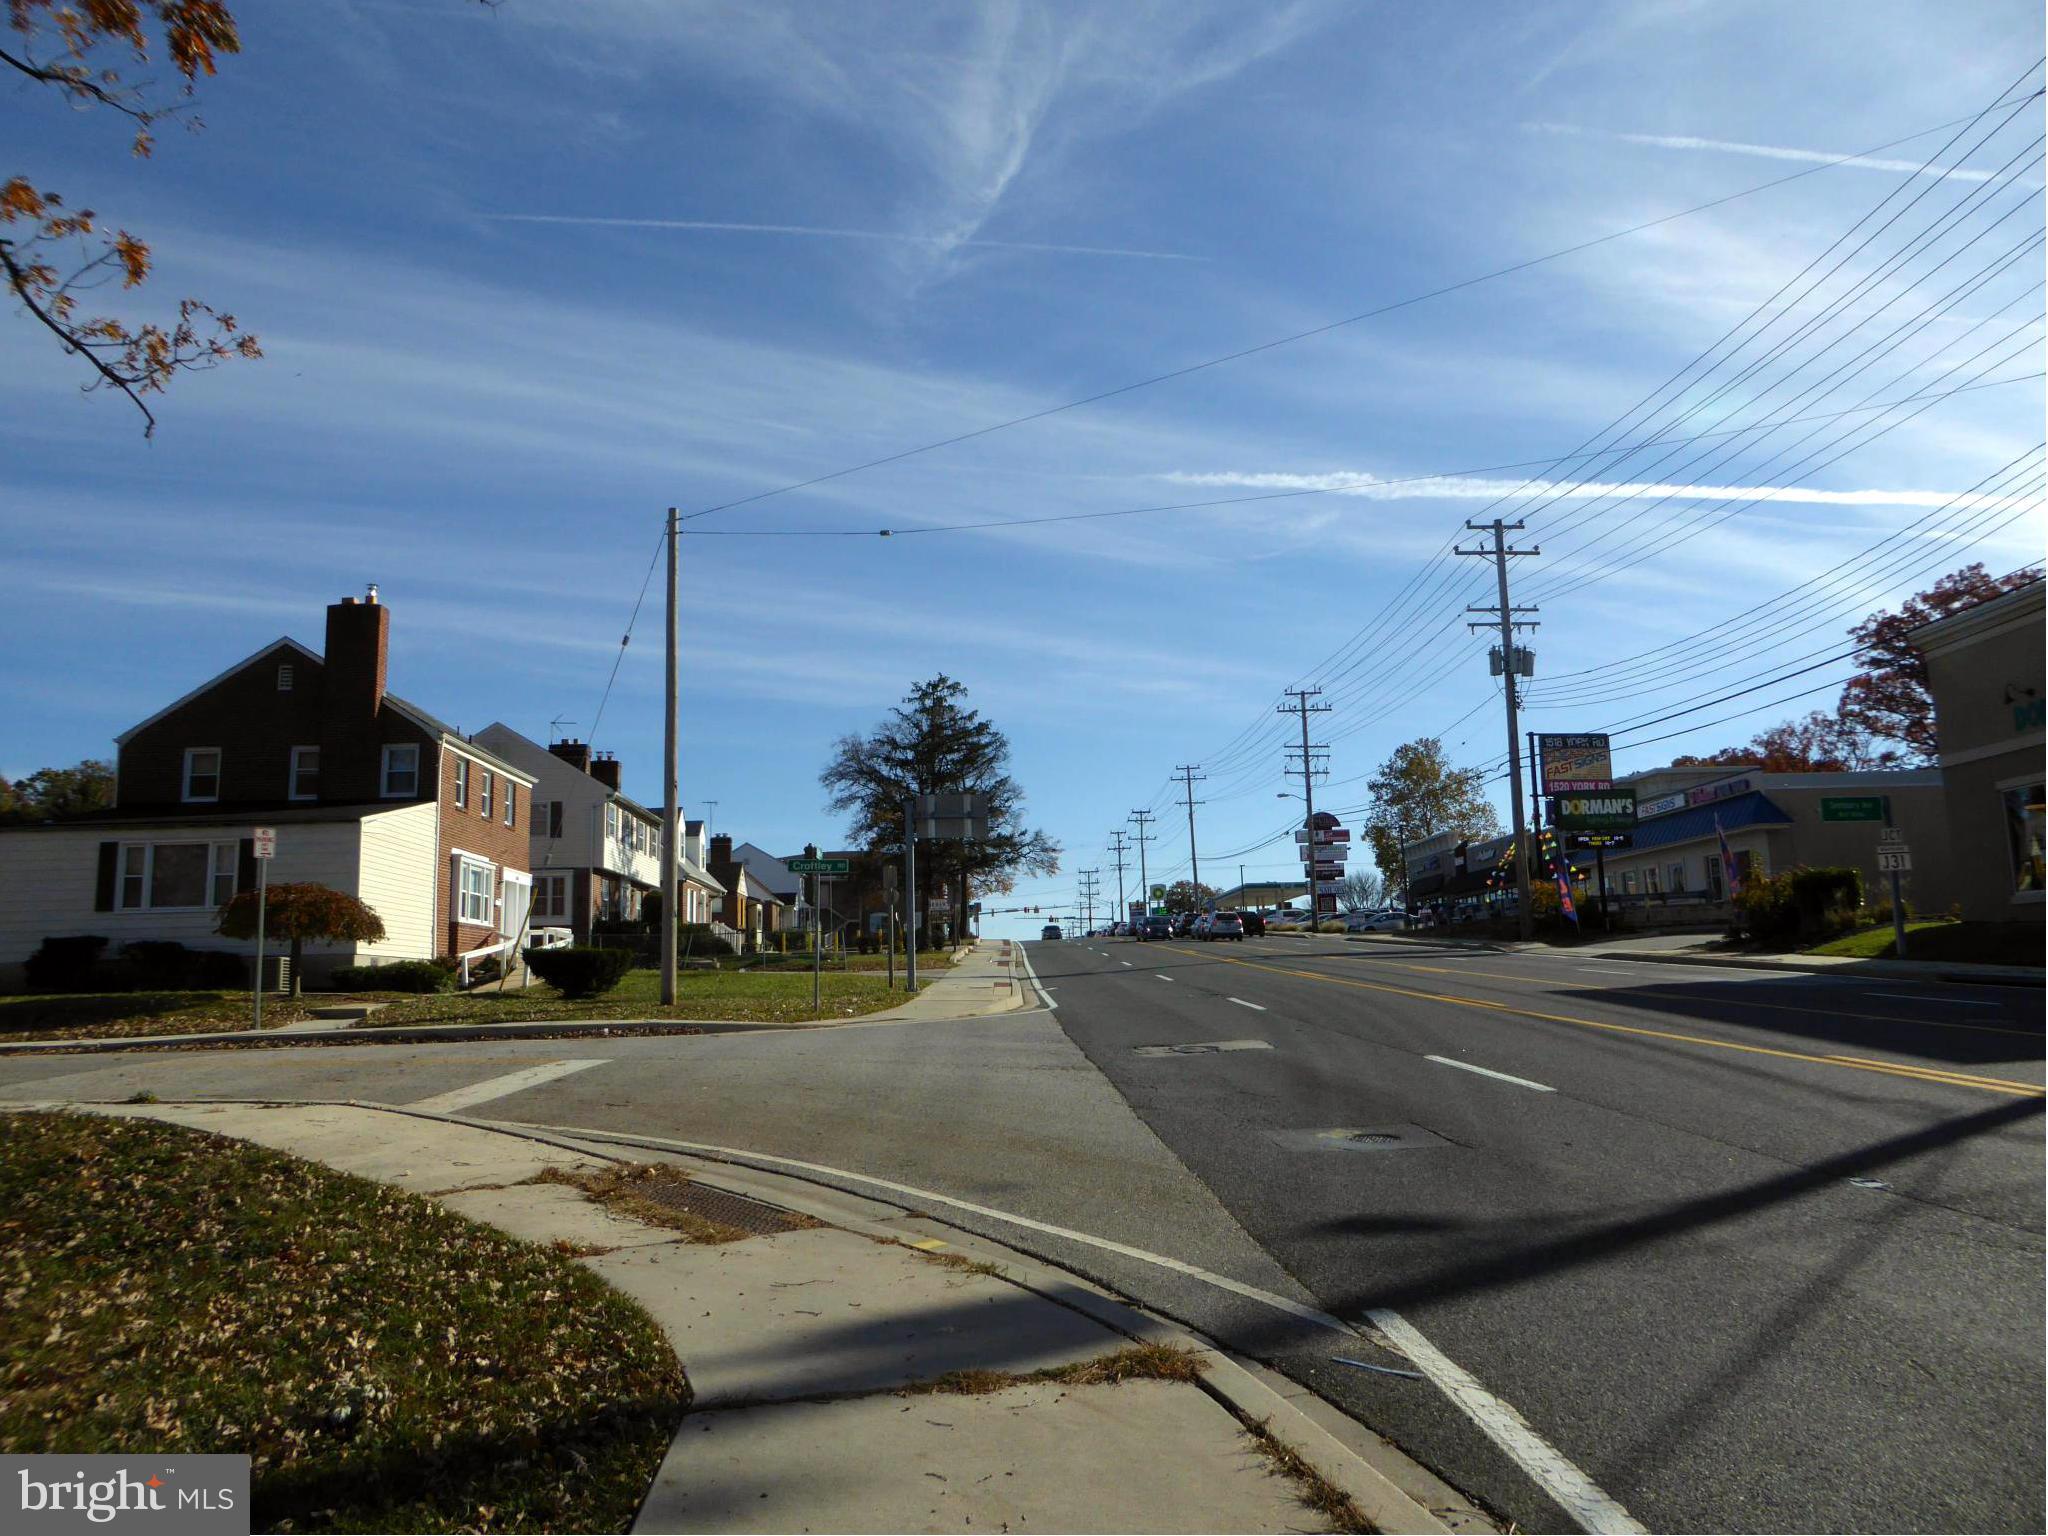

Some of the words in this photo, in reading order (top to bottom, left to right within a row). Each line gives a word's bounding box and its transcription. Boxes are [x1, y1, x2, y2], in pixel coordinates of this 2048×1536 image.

[1545, 737, 1563, 747] 1518
[1567, 737, 1590, 747] YORK
[1549, 782, 1570, 792] 1520
[1571, 782, 1597, 791] YORK
[1561, 798, 1634, 815] DORMAN'S
[1881, 829, 1901, 841] JCT
[792, 861, 833, 872] Croftley
[1883, 855, 1905, 869] 131
